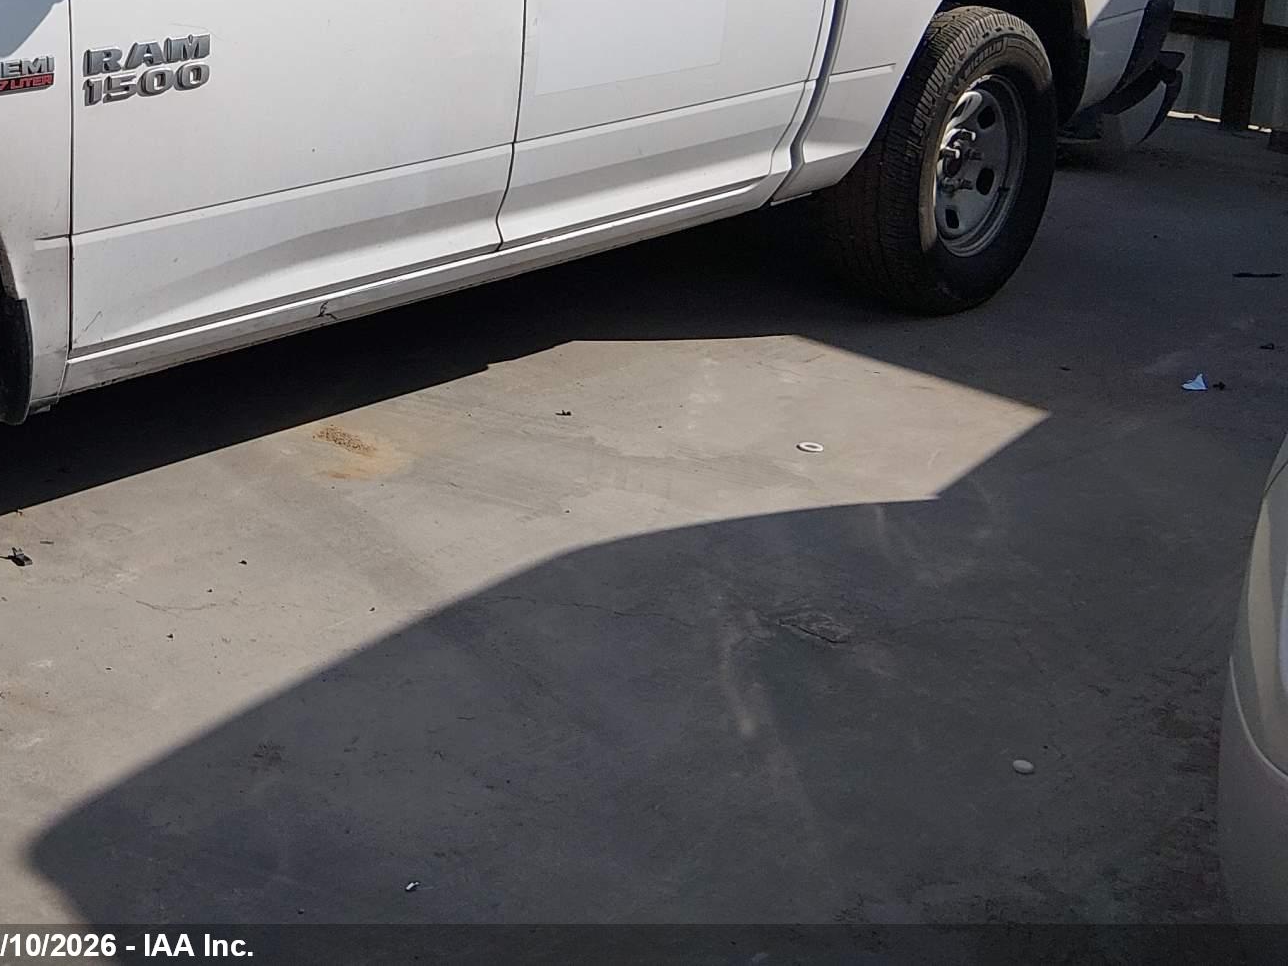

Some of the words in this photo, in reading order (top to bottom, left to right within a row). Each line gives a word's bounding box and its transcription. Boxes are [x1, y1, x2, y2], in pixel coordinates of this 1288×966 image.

[83, 33, 211, 77] RAM
[10, 73, 55, 91] LITER
[81, 61, 211, 107] 1500
